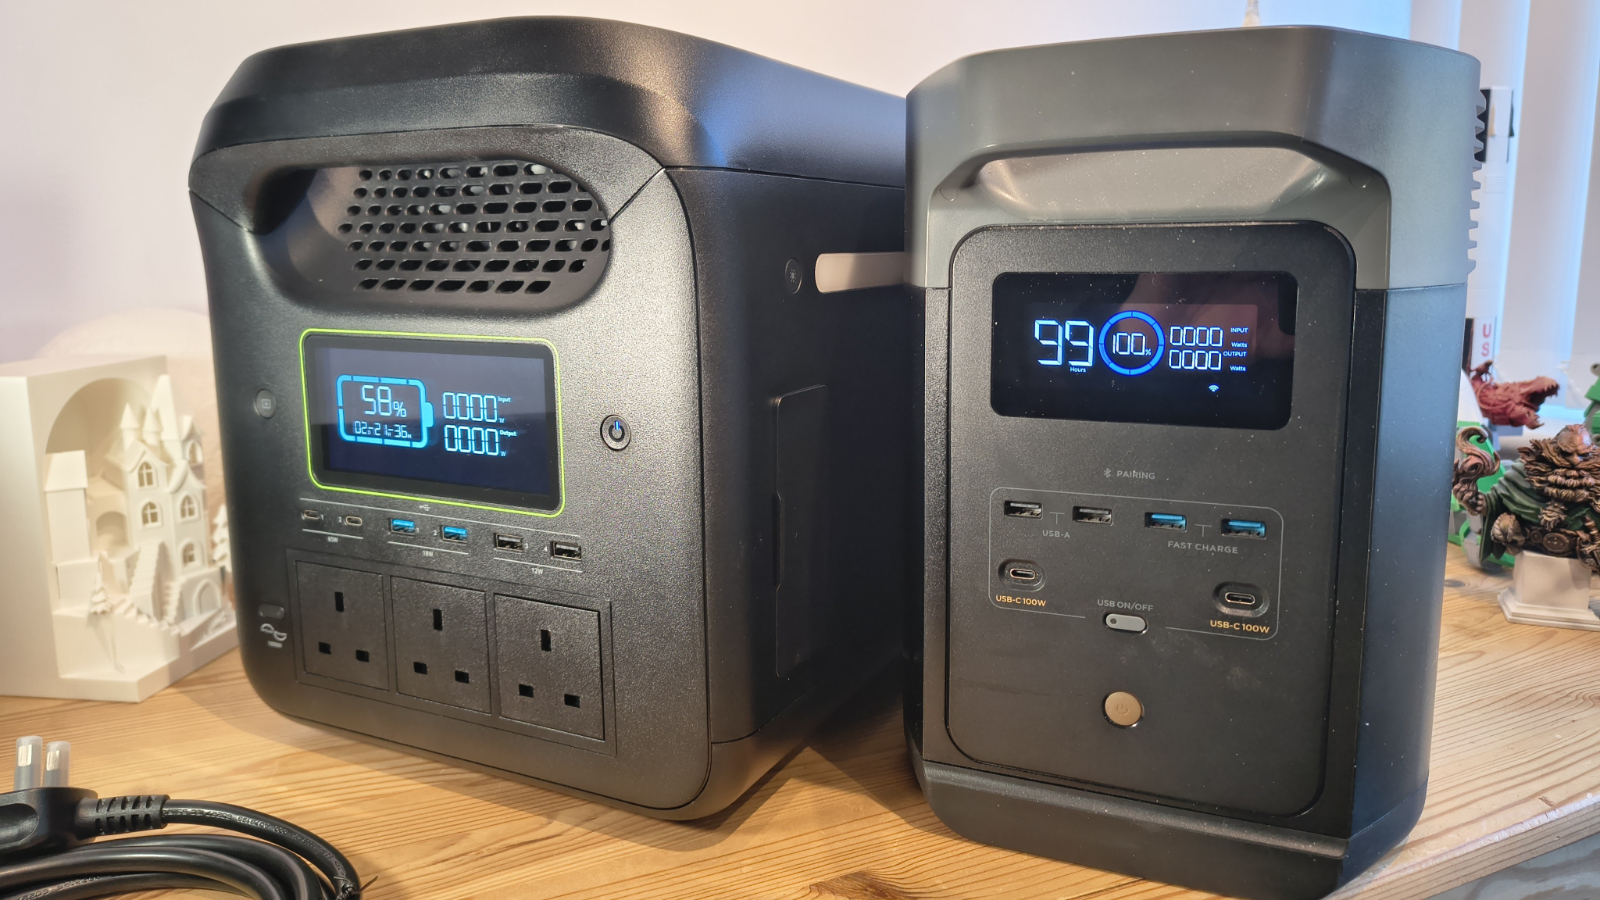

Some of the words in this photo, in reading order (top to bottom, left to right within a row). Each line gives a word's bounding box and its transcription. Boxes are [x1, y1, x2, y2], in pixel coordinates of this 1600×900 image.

[1169, 326, 1224, 347] 0000
[1168, 349, 1222, 371] 0000
[442, 391, 498, 423] 0000
[444, 424, 499, 456] 0000
[499, 429, 517, 438] Output
[1116, 470, 1156, 480] PAIRING
[1042, 530, 1071, 539] USB-A
[1167, 540, 1192, 550] FAST
[1195, 543, 1238, 554] CHARGE
[995, 595, 1021, 605] USB-C
[1022, 597, 1047, 607] 100W
[1097, 599, 1115, 608] USB
[1116, 600, 1154, 612] ON/OFF
[1209, 619, 1241, 631] USB-C
[1241, 622, 1270, 634] 100W
